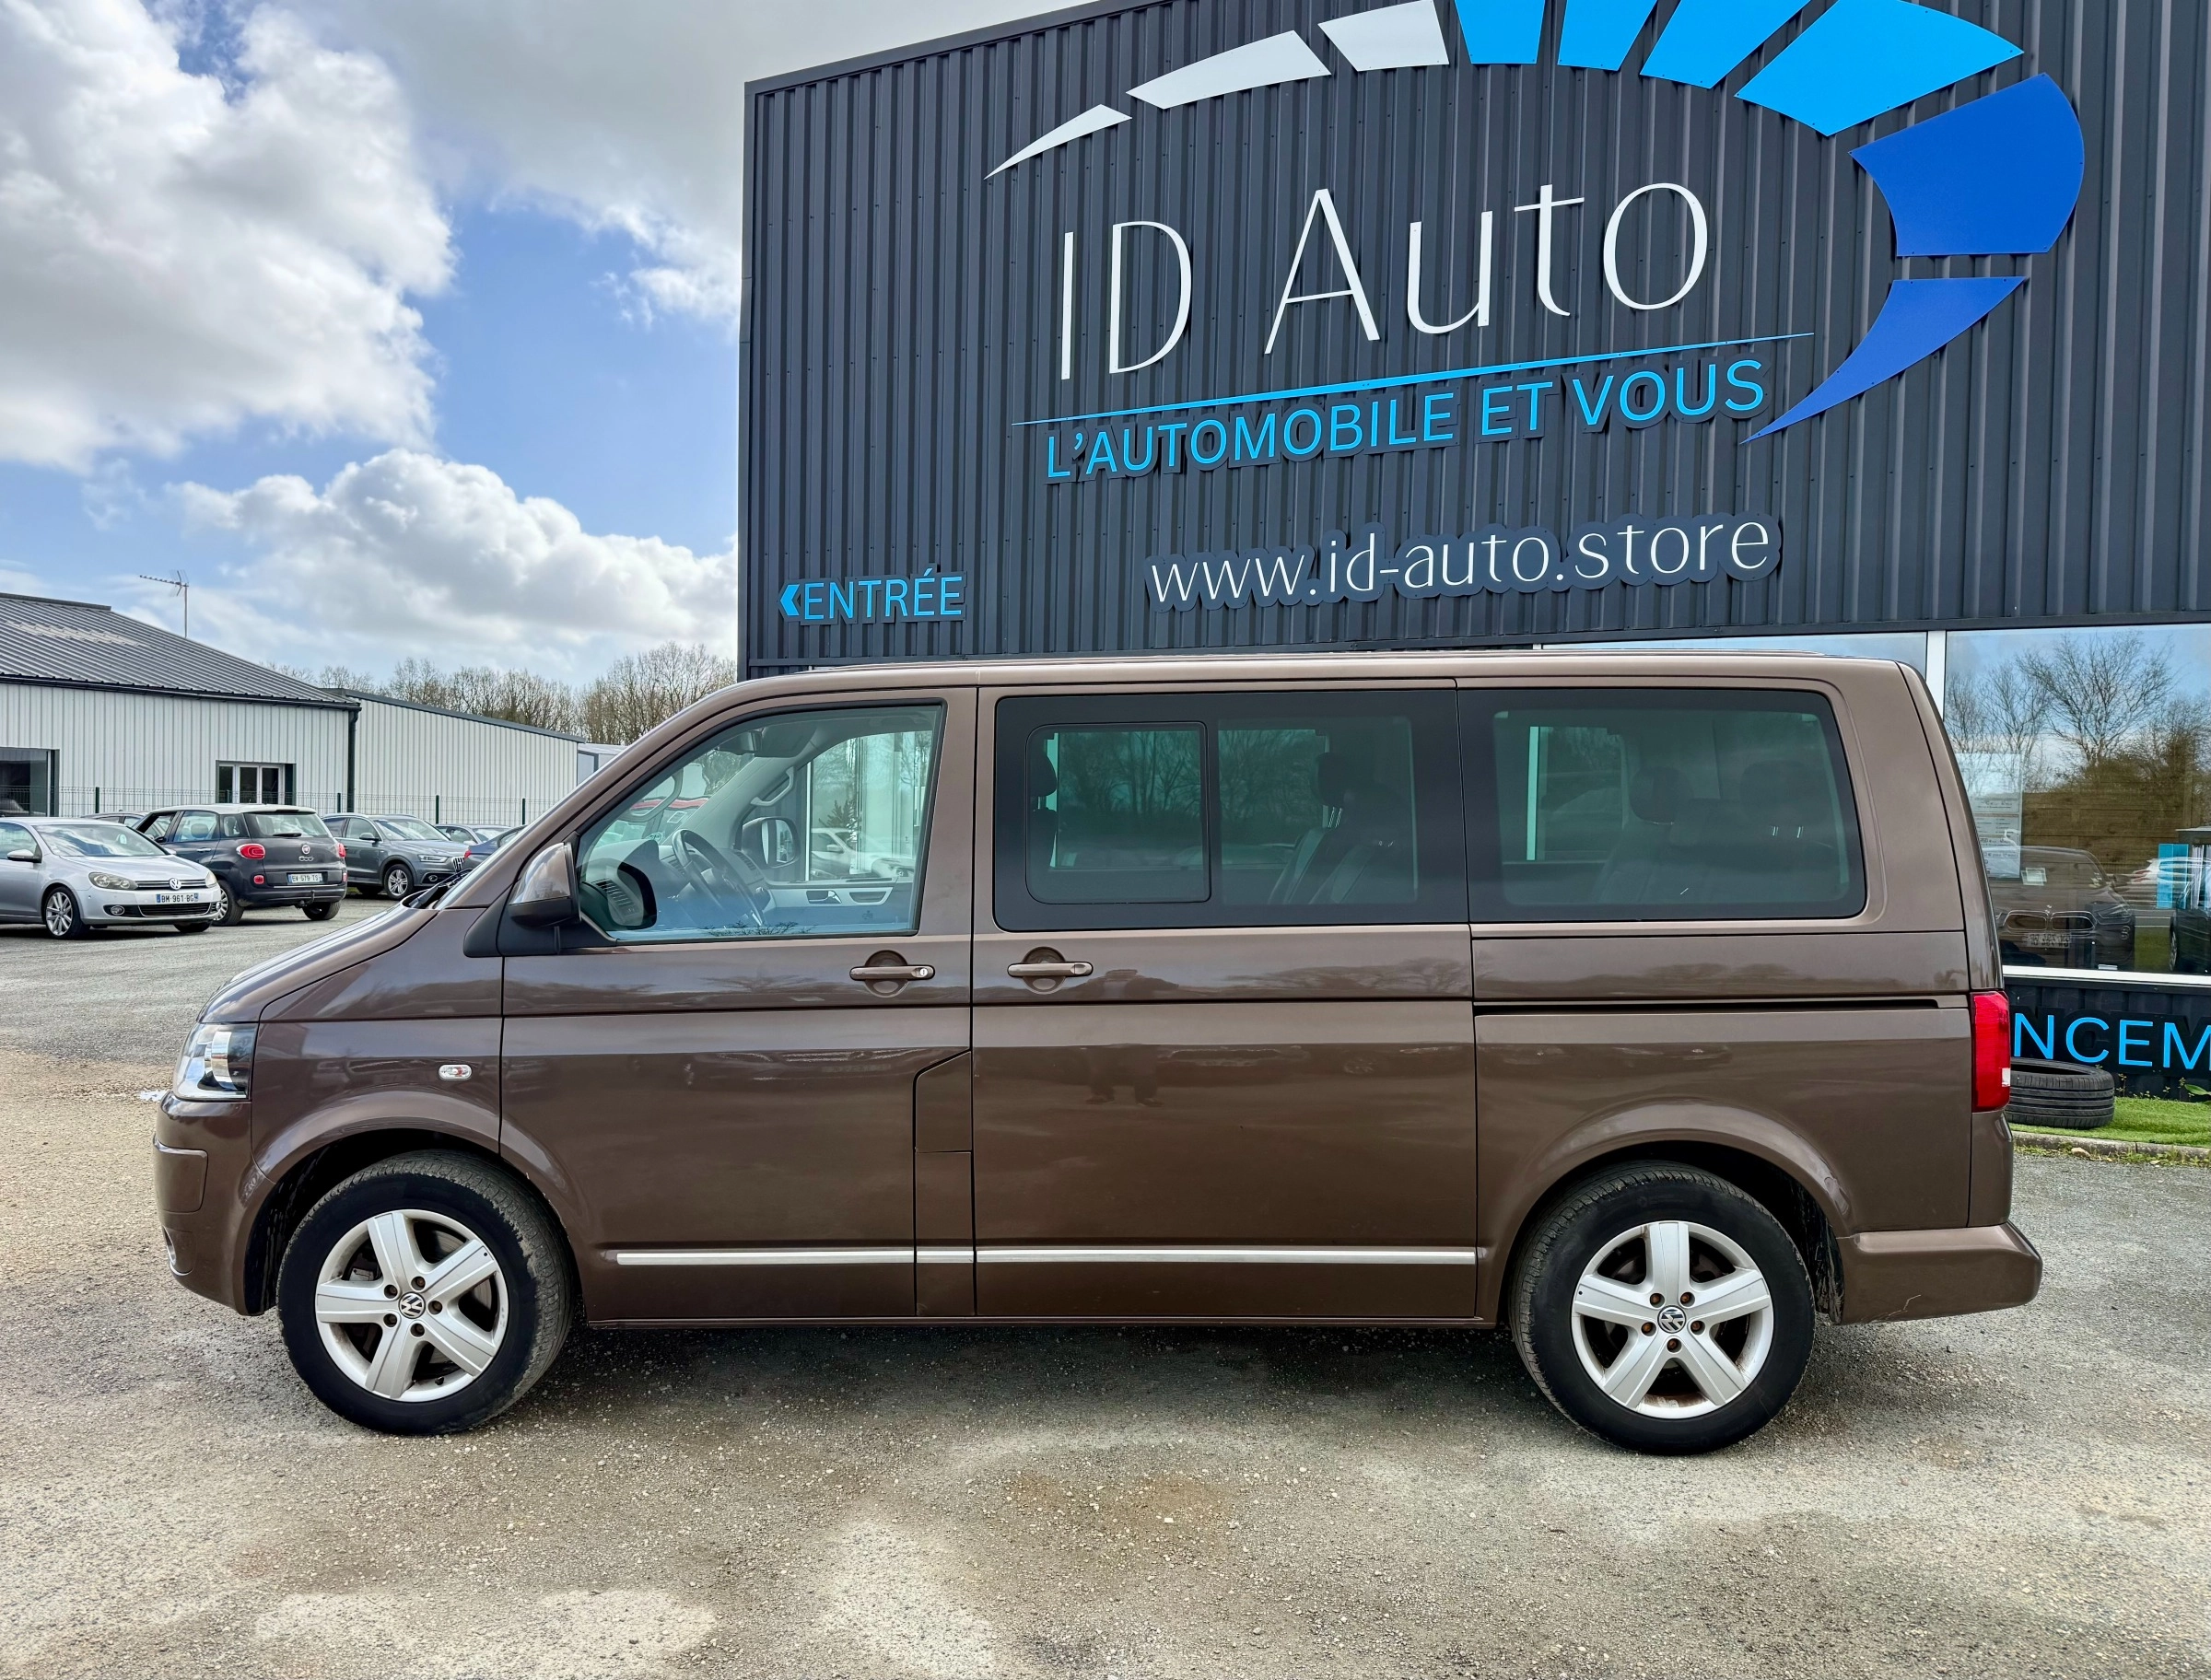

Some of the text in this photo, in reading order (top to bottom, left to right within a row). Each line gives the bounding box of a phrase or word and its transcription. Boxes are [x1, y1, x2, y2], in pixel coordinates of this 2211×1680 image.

[1060, 182, 1709, 380] ID Auto
[1047, 359, 1765, 478] L'AUTOMOBILE ET VOUS
[804, 567, 963, 620] ENTRÉE
[1151, 521, 1770, 603] www.id-auto.store
